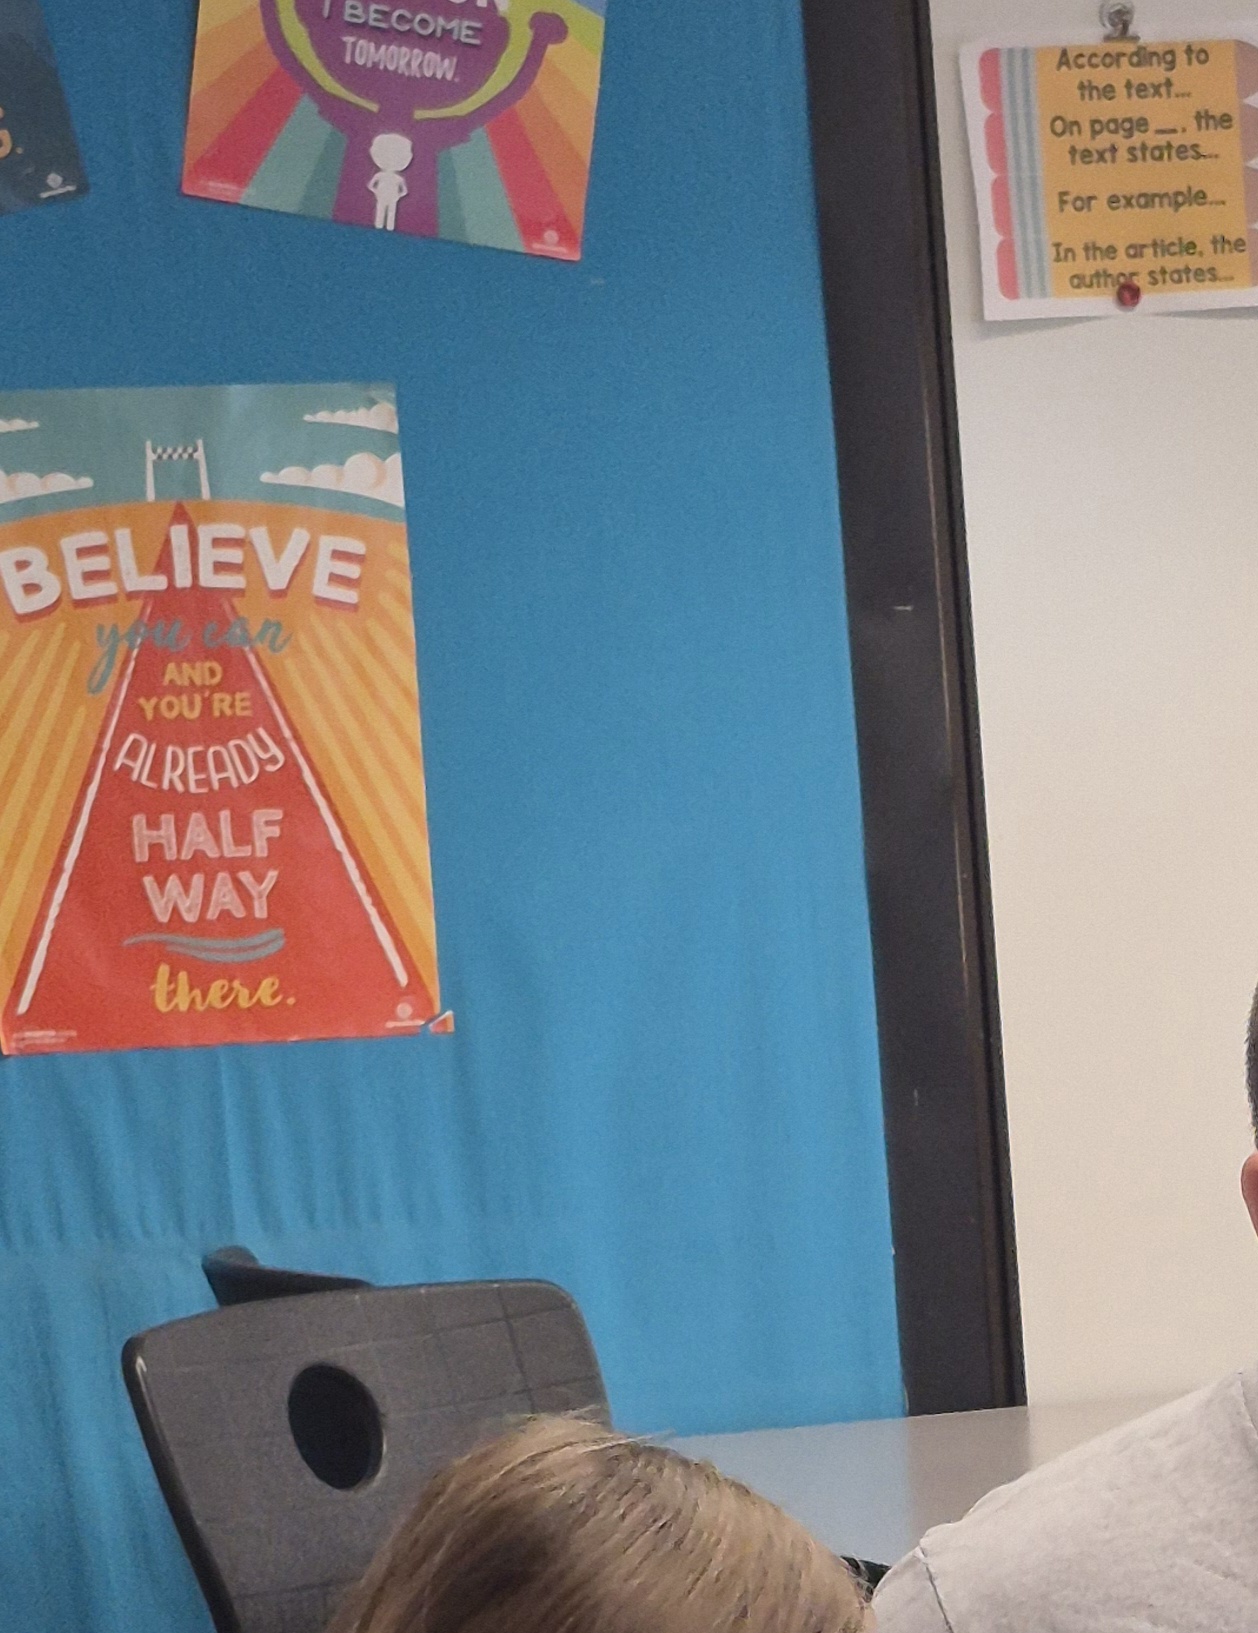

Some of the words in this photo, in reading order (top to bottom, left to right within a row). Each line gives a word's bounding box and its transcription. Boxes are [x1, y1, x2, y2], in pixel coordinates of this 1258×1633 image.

[343, 0, 482, 45] BECOME
[341, 36, 460, 82] TOMORROW.
[1056, 45, 1176, 72] According
[1185, 44, 1210, 66] to
[1077, 80, 1116, 101] the
[1050, 115, 1082, 138] On
[1089, 115, 1149, 140] page
[1195, 109, 1233, 132] the
[1068, 143, 1118, 166] text
[1057, 190, 1098, 213] For
[1052, 241, 1076, 263] In
[1082, 240, 1118, 262] the
[1209, 234, 1247, 255] the
[0, 523, 367, 618] BELIEVE
[87, 617, 191, 695] you
[203, 617, 292, 654] can
[163, 661, 223, 687] AND
[138, 691, 252, 721] YOU'RE
[114, 728, 285, 794] ALREADY
[132, 809, 284, 862] HALF
[142, 870, 279, 923] WAY
[150, 963, 296, 1012] there.
